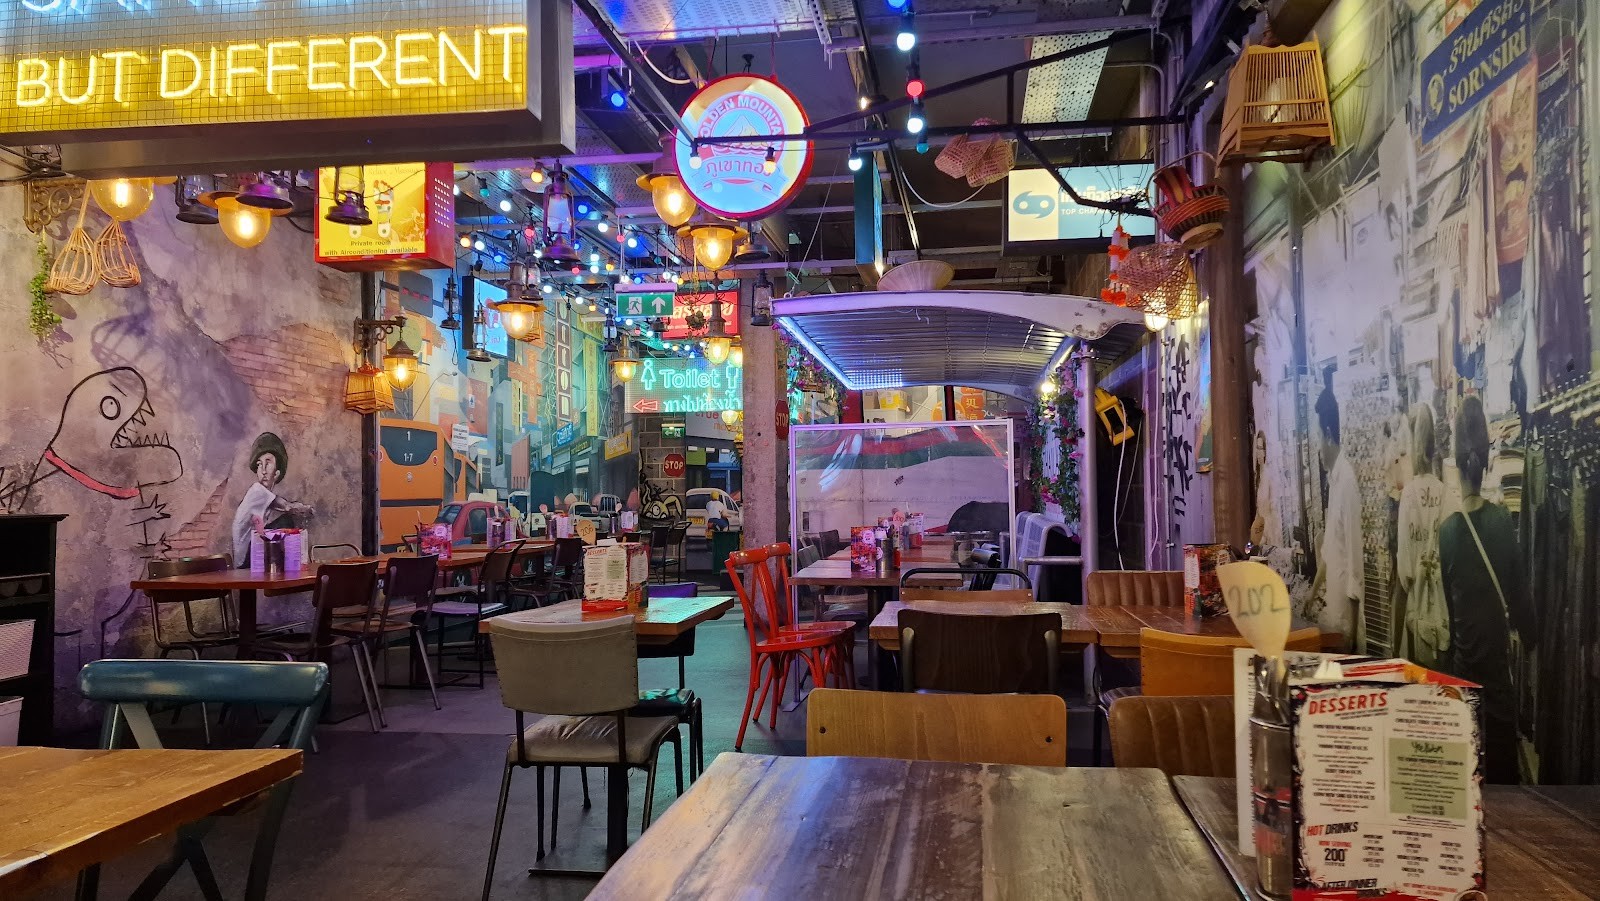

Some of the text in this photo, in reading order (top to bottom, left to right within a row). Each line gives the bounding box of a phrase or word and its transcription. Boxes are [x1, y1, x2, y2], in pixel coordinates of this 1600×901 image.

[16, 24, 528, 108] BUT DIFFERENT
[737, 93, 783, 150] MOUNTAN
[389, 246, 418, 254] available
[659, 368, 721, 389] Toilet
[406, 430, 411, 441] 1
[665, 459, 684, 471] STOP
[580, 525, 594, 537] 206
[1228, 584, 1291, 618] 202
[1308, 692, 1389, 715] DESSERTS
[1306, 821, 1359, 837] HOT DRINKS
